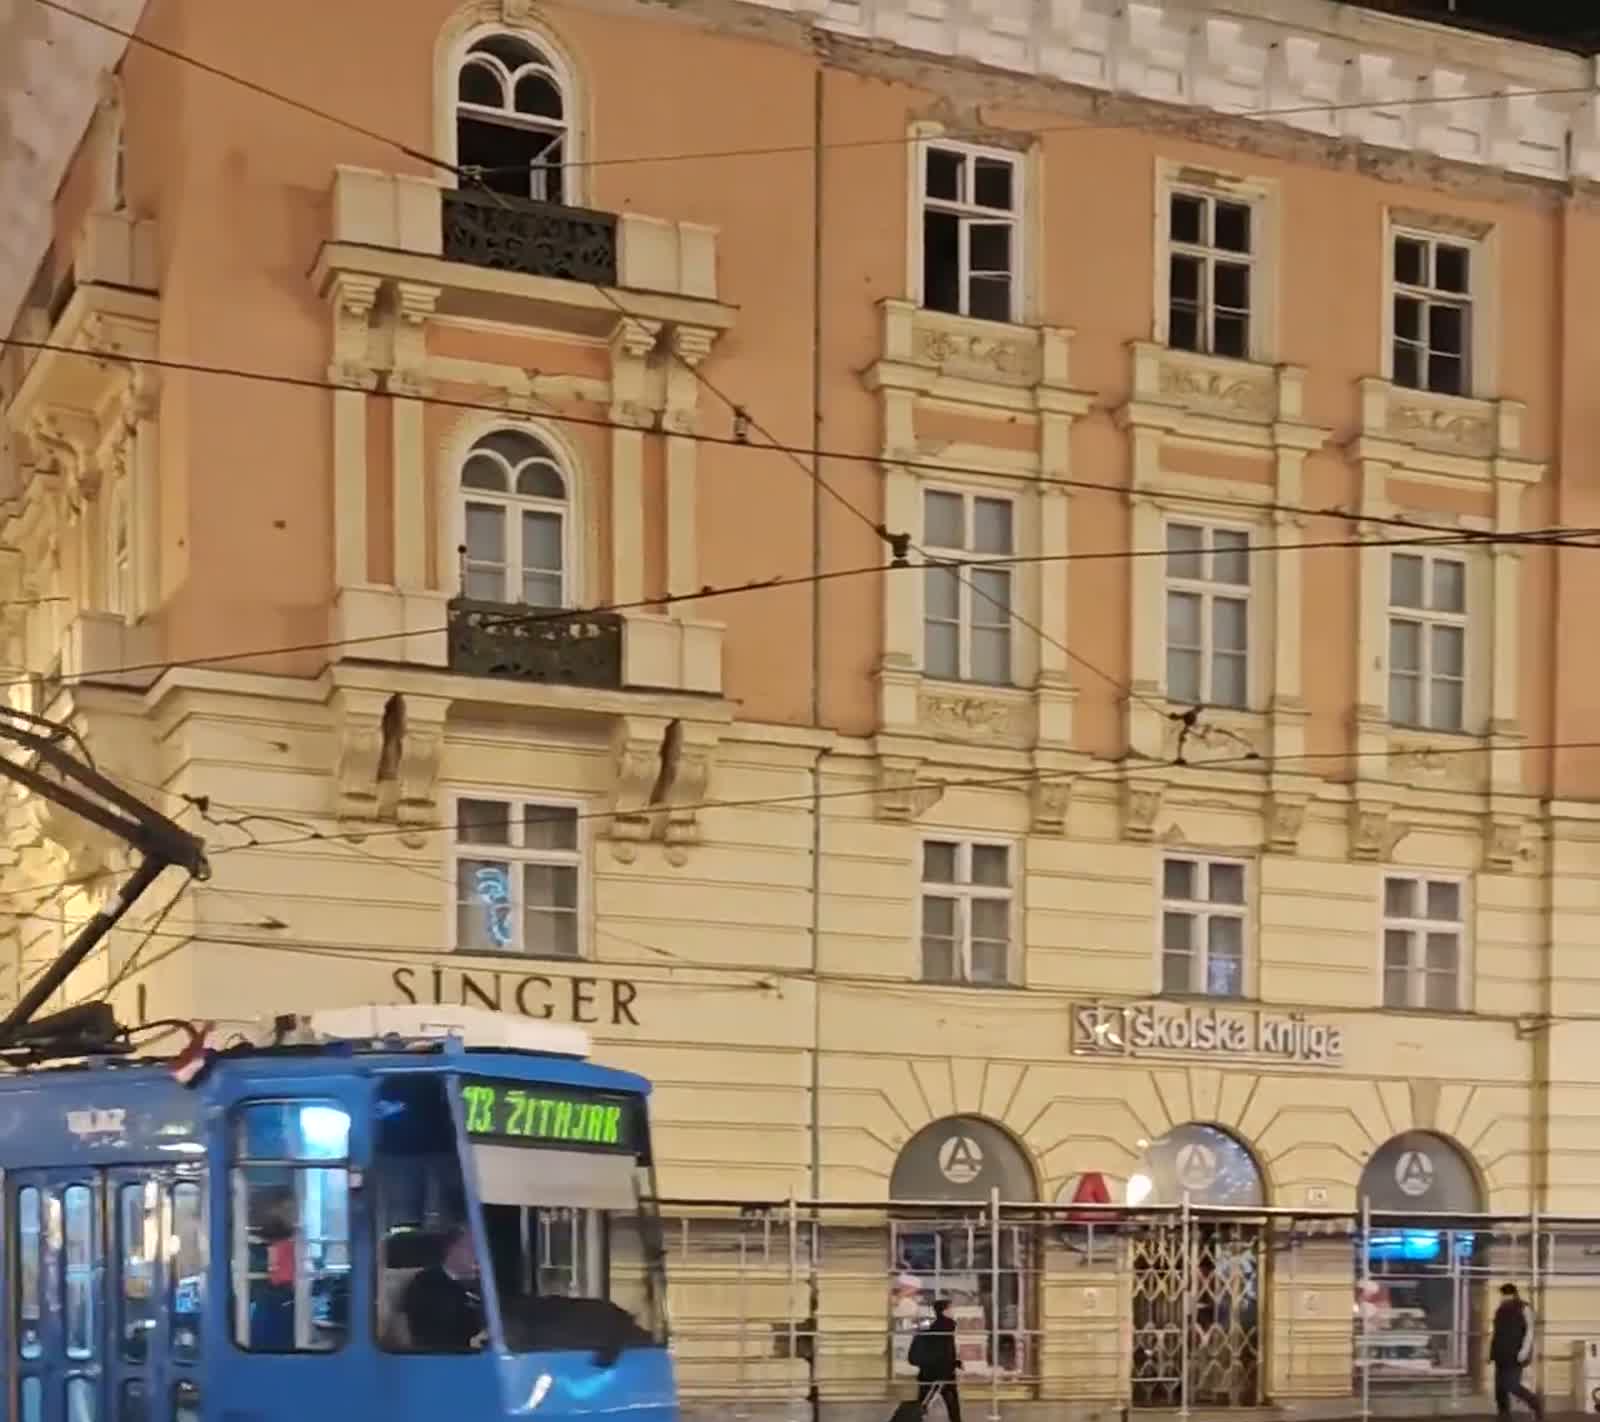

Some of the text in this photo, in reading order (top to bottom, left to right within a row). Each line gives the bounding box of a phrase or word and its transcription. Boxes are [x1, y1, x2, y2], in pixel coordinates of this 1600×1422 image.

[391, 966, 640, 1026] SINGER
[1257, 1009, 1344, 1060] knjiga
[463, 1086, 496, 1132] 13
